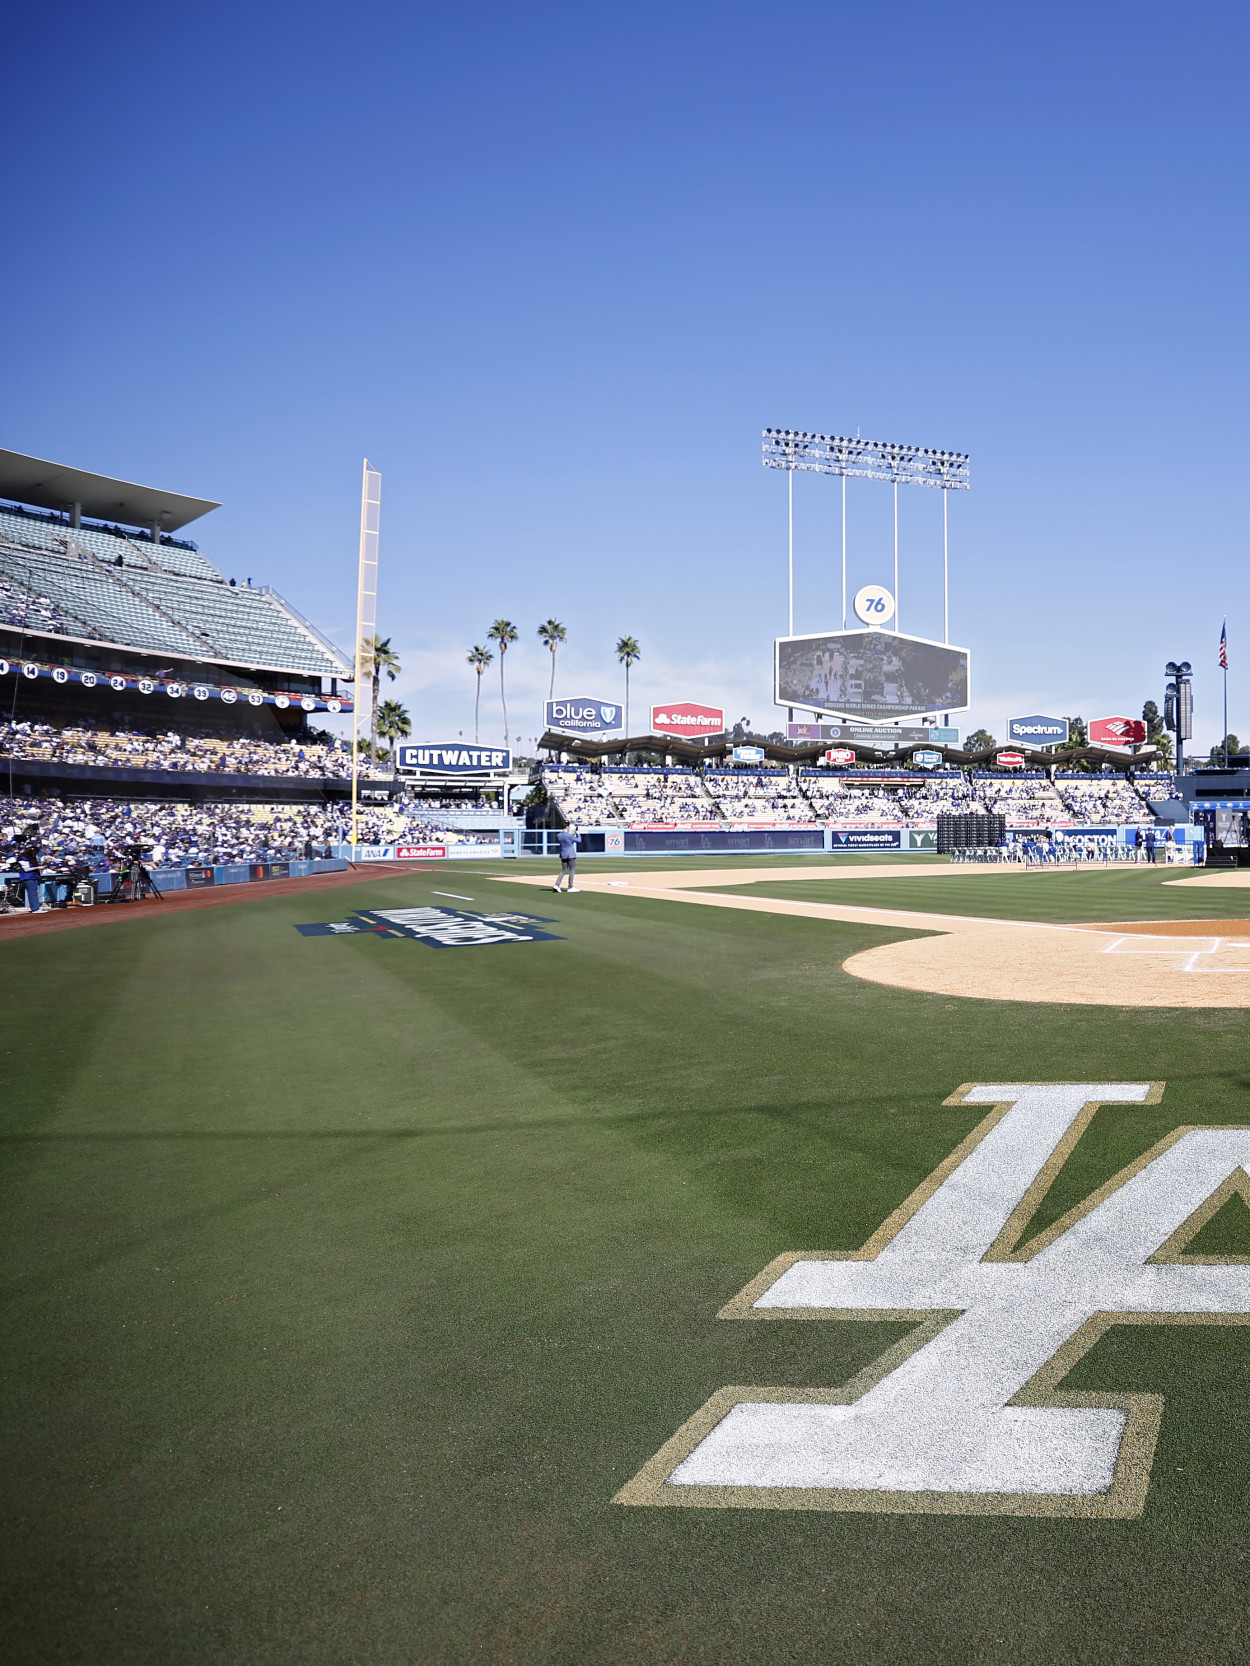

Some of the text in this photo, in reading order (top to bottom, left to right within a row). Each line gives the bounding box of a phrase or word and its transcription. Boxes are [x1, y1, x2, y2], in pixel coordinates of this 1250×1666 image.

[865, 597, 886, 612] 76
[26, 667, 35, 676] 14
[56, 671, 65, 680] 19
[84, 675, 94, 684] 20
[113, 679, 124, 688] 24
[141, 682, 151, 691] 32
[170, 686, 179, 695] 34
[197, 689, 207, 698] 39
[222, 691, 236, 702] 42
[251, 694, 261, 703] 53
[552, 702, 596, 719] blue
[559, 719, 601, 728] california
[874, 727, 902, 735] AUCTION
[1012, 723, 1060, 736] Spectrum
[405, 748, 502, 767] CUTWATER
[608, 838, 620, 846] 76
[788, 836, 814, 844] smart
[848, 833, 893, 842] vividseats
[364, 850, 381, 858] ANA
